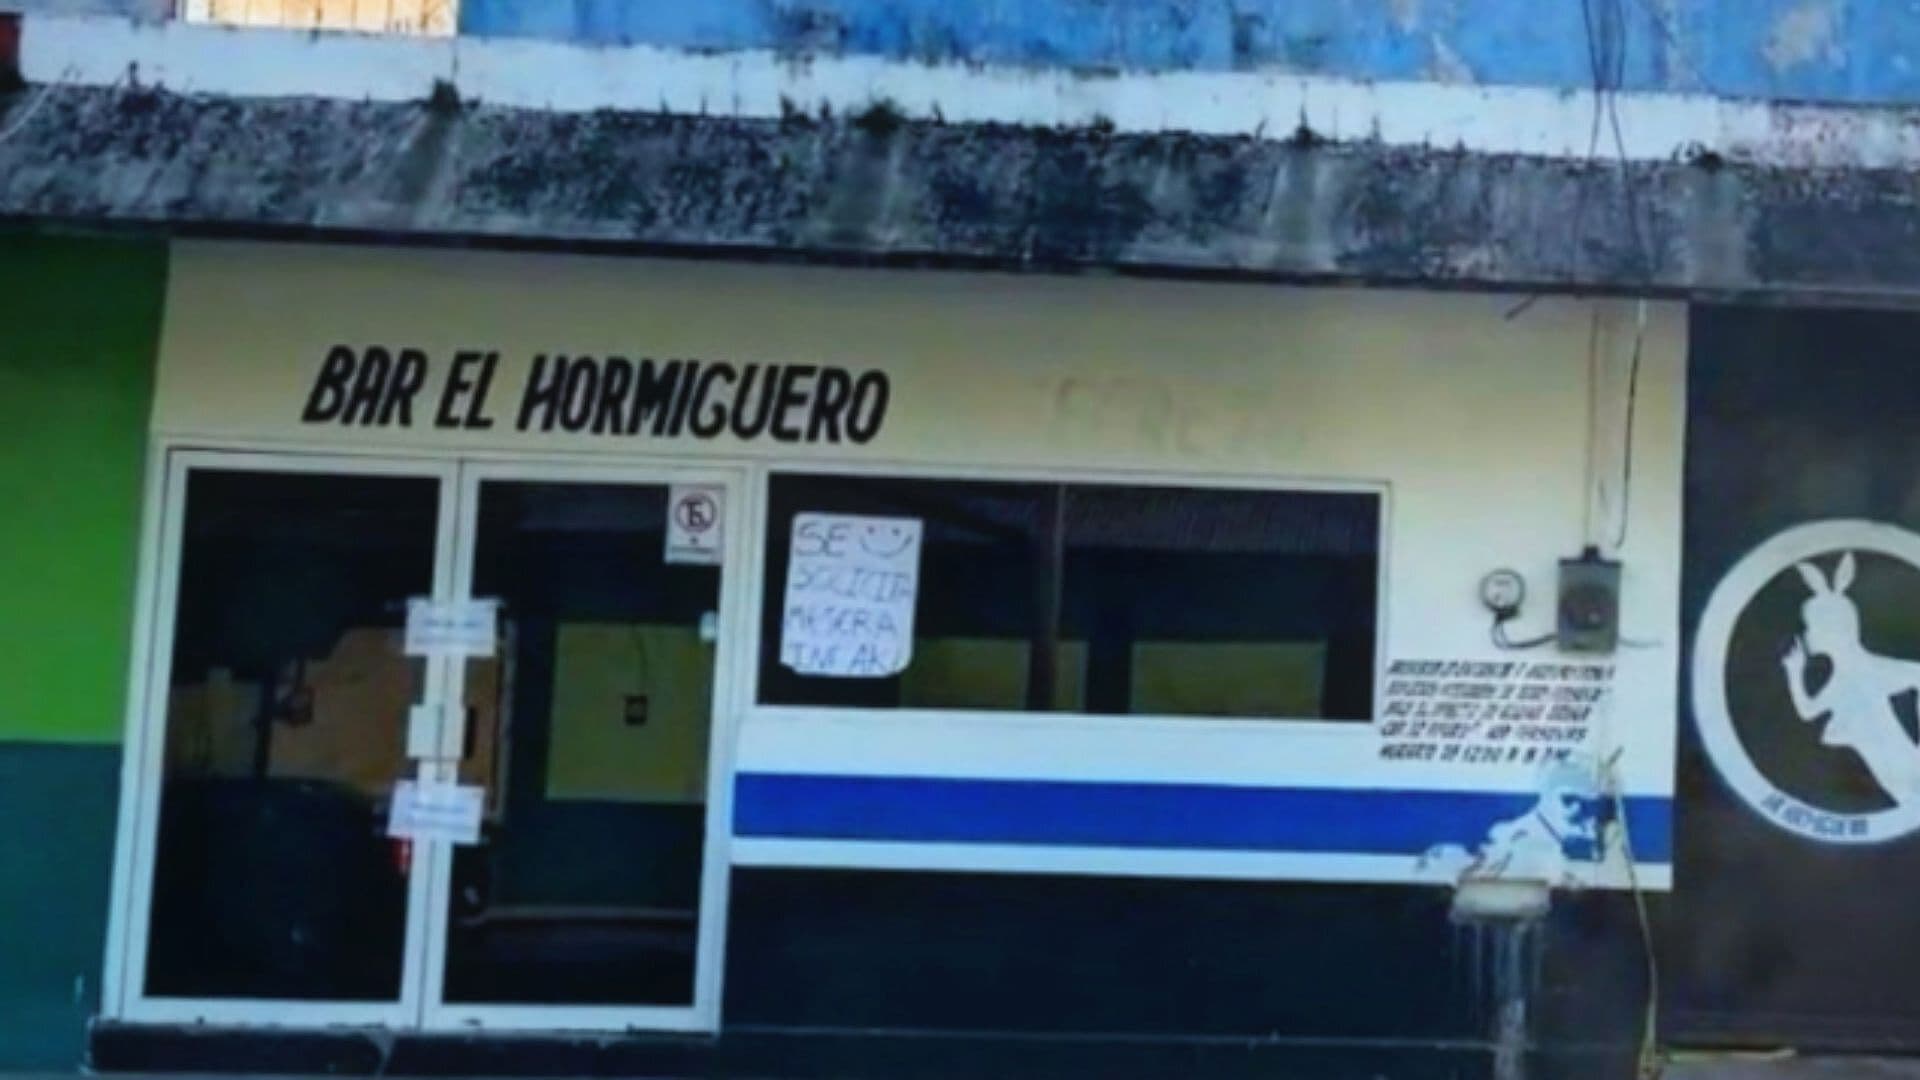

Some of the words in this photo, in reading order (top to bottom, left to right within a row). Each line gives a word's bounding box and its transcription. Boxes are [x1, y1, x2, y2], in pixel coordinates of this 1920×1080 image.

[301, 345, 429, 427] BAR
[435, 351, 500, 430] EL
[516, 354, 891, 444] HORMIGUERO
[797, 522, 850, 557] SE
